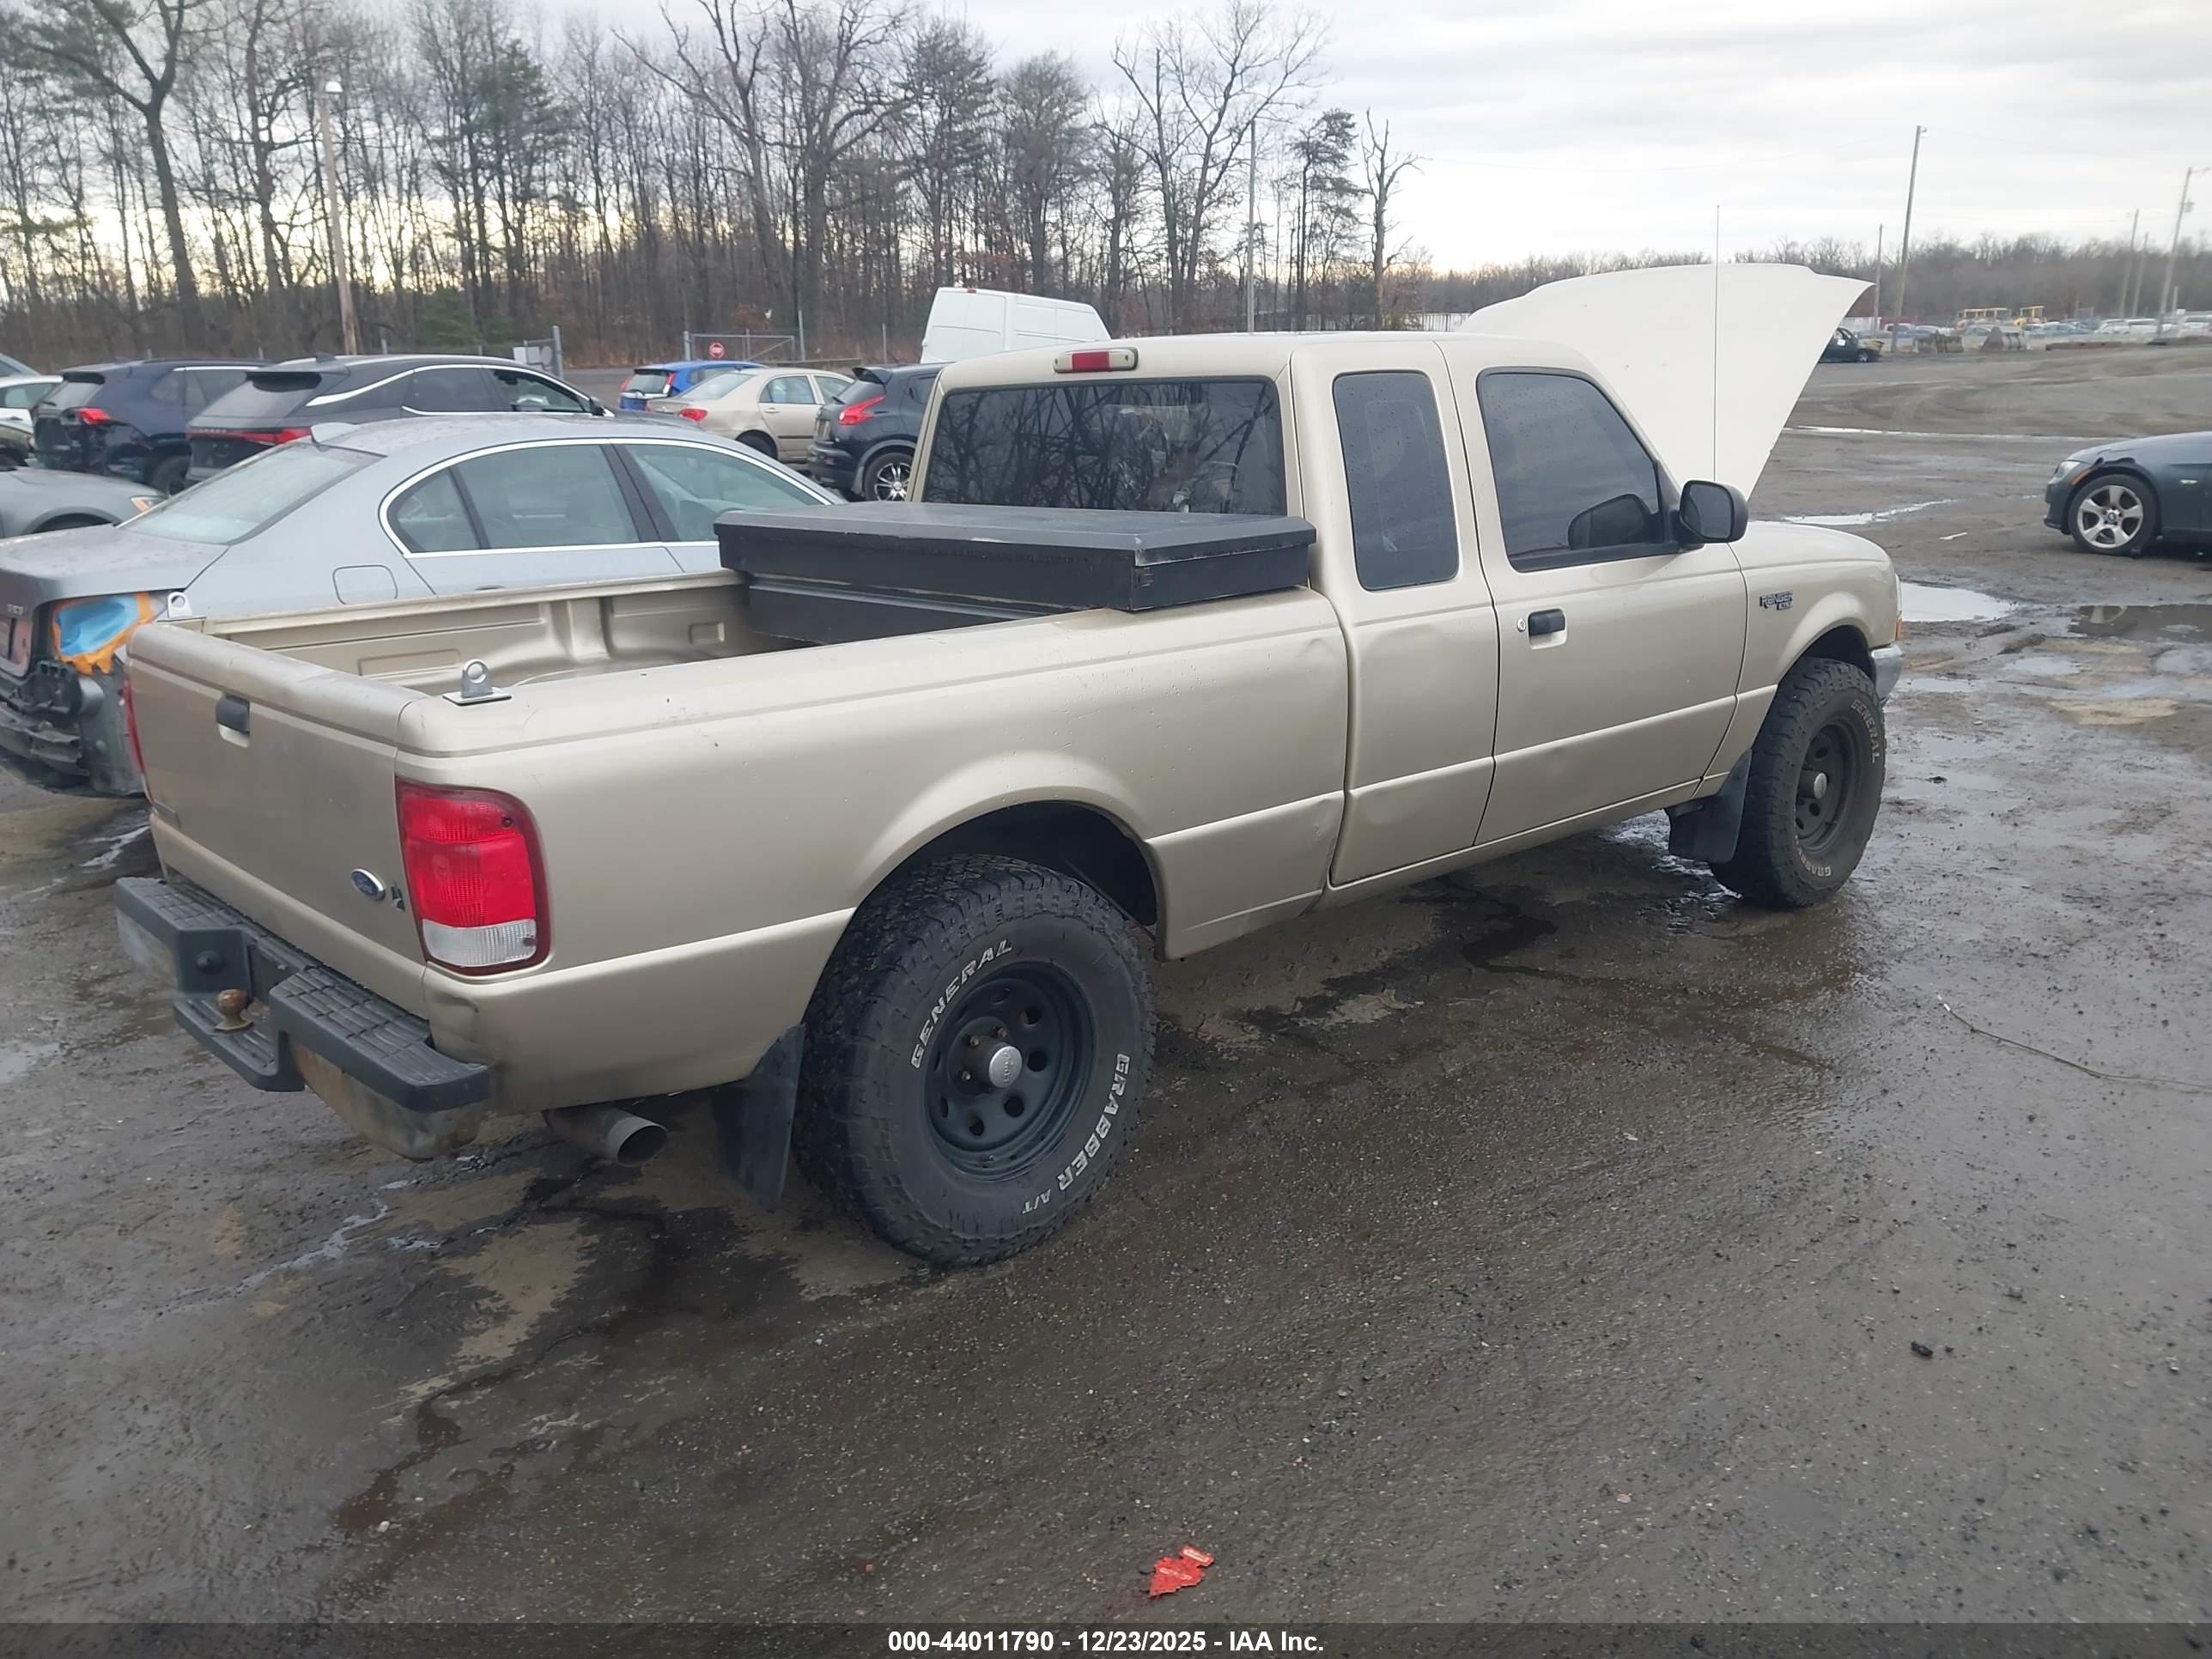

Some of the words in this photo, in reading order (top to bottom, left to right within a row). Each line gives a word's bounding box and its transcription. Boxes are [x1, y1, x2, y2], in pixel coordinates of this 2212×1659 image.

[1850, 699, 1881, 763] GENERAL
[910, 939, 1012, 1068] GENERAL
[1057, 1053, 1131, 1191] GRABBER
[1022, 1188, 1052, 1214] A/T
